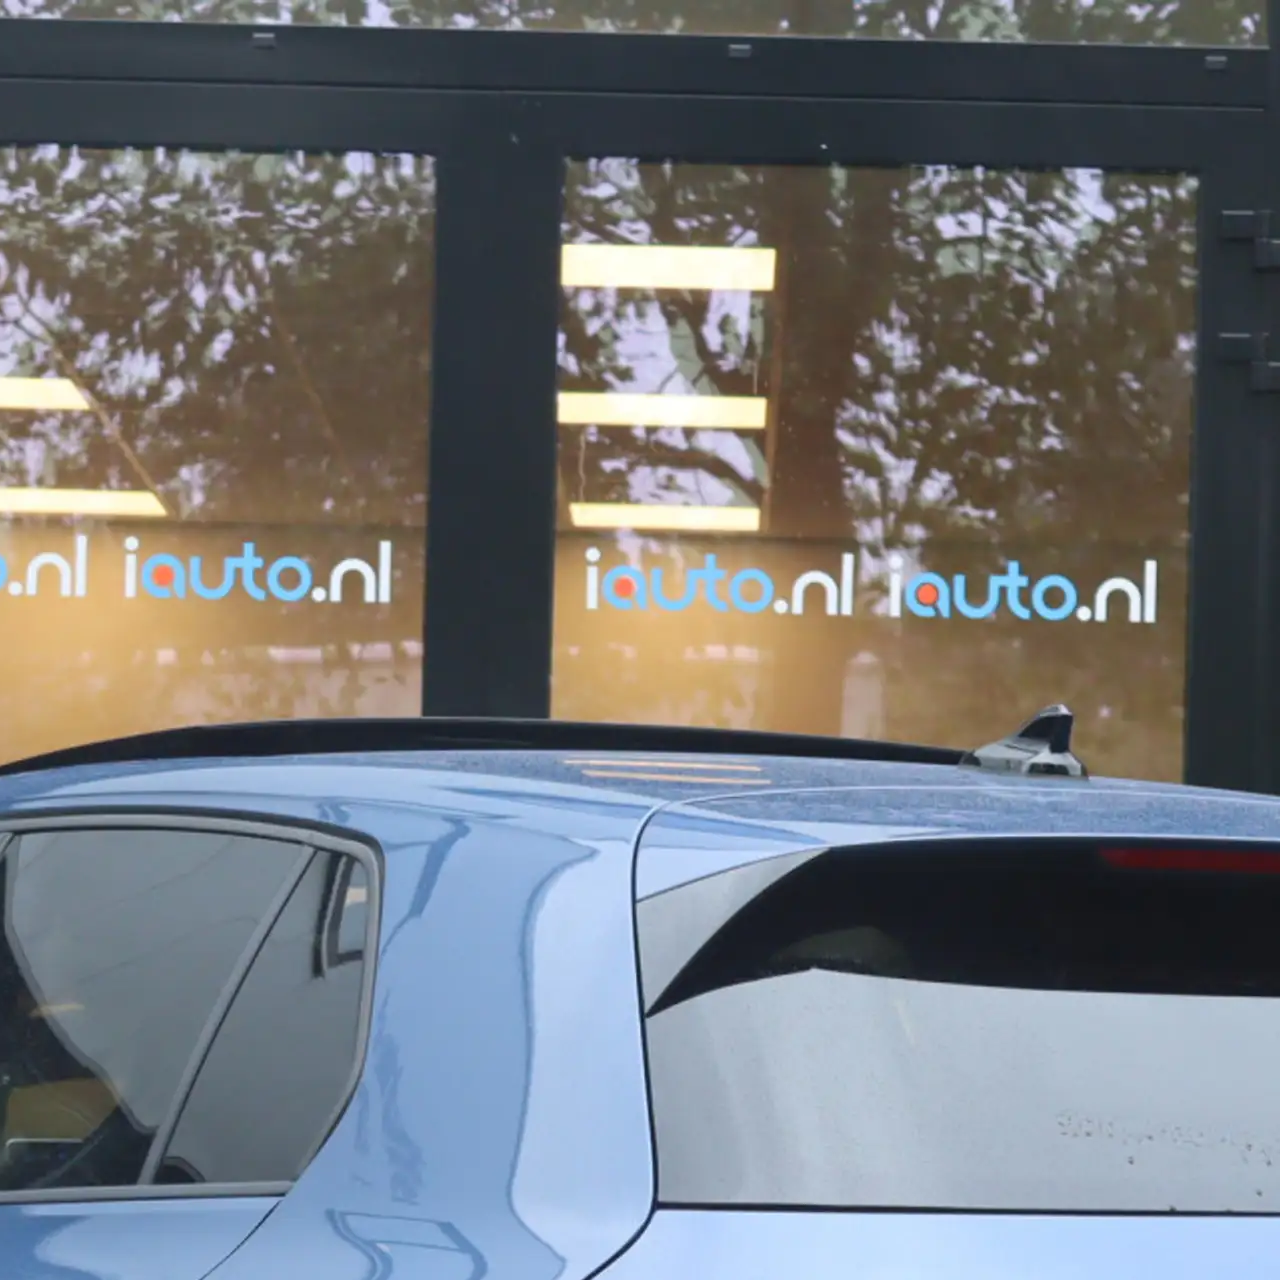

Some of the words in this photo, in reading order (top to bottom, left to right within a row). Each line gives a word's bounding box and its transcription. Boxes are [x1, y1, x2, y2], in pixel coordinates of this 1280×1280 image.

[124, 536, 391, 604] iauto.nl
[585, 547, 854, 618] iauto.nl
[890, 554, 1157, 624] iauto.nl
